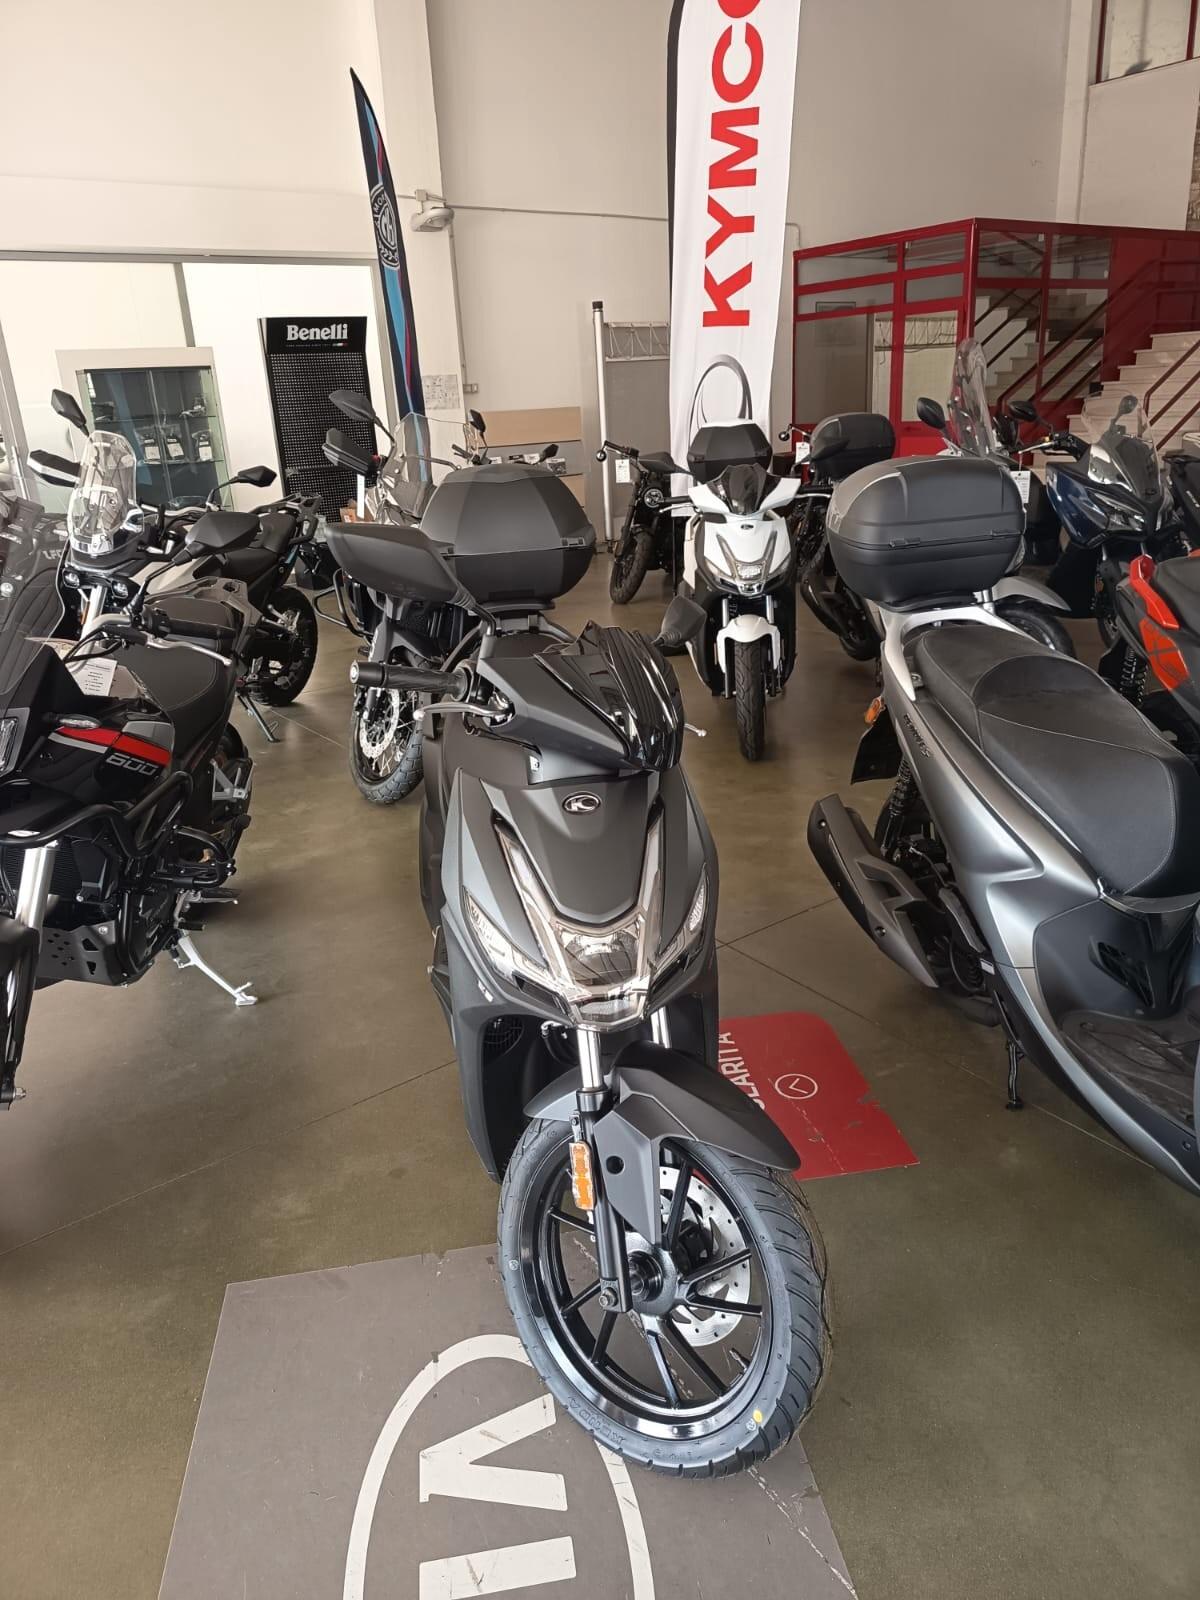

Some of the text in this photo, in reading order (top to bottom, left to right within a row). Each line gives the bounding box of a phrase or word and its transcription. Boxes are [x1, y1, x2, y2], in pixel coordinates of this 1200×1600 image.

[703, 0, 764, 327] KYMC
[286, 323, 348, 341] Benelli
[718, 1032, 766, 1110] LARITA
